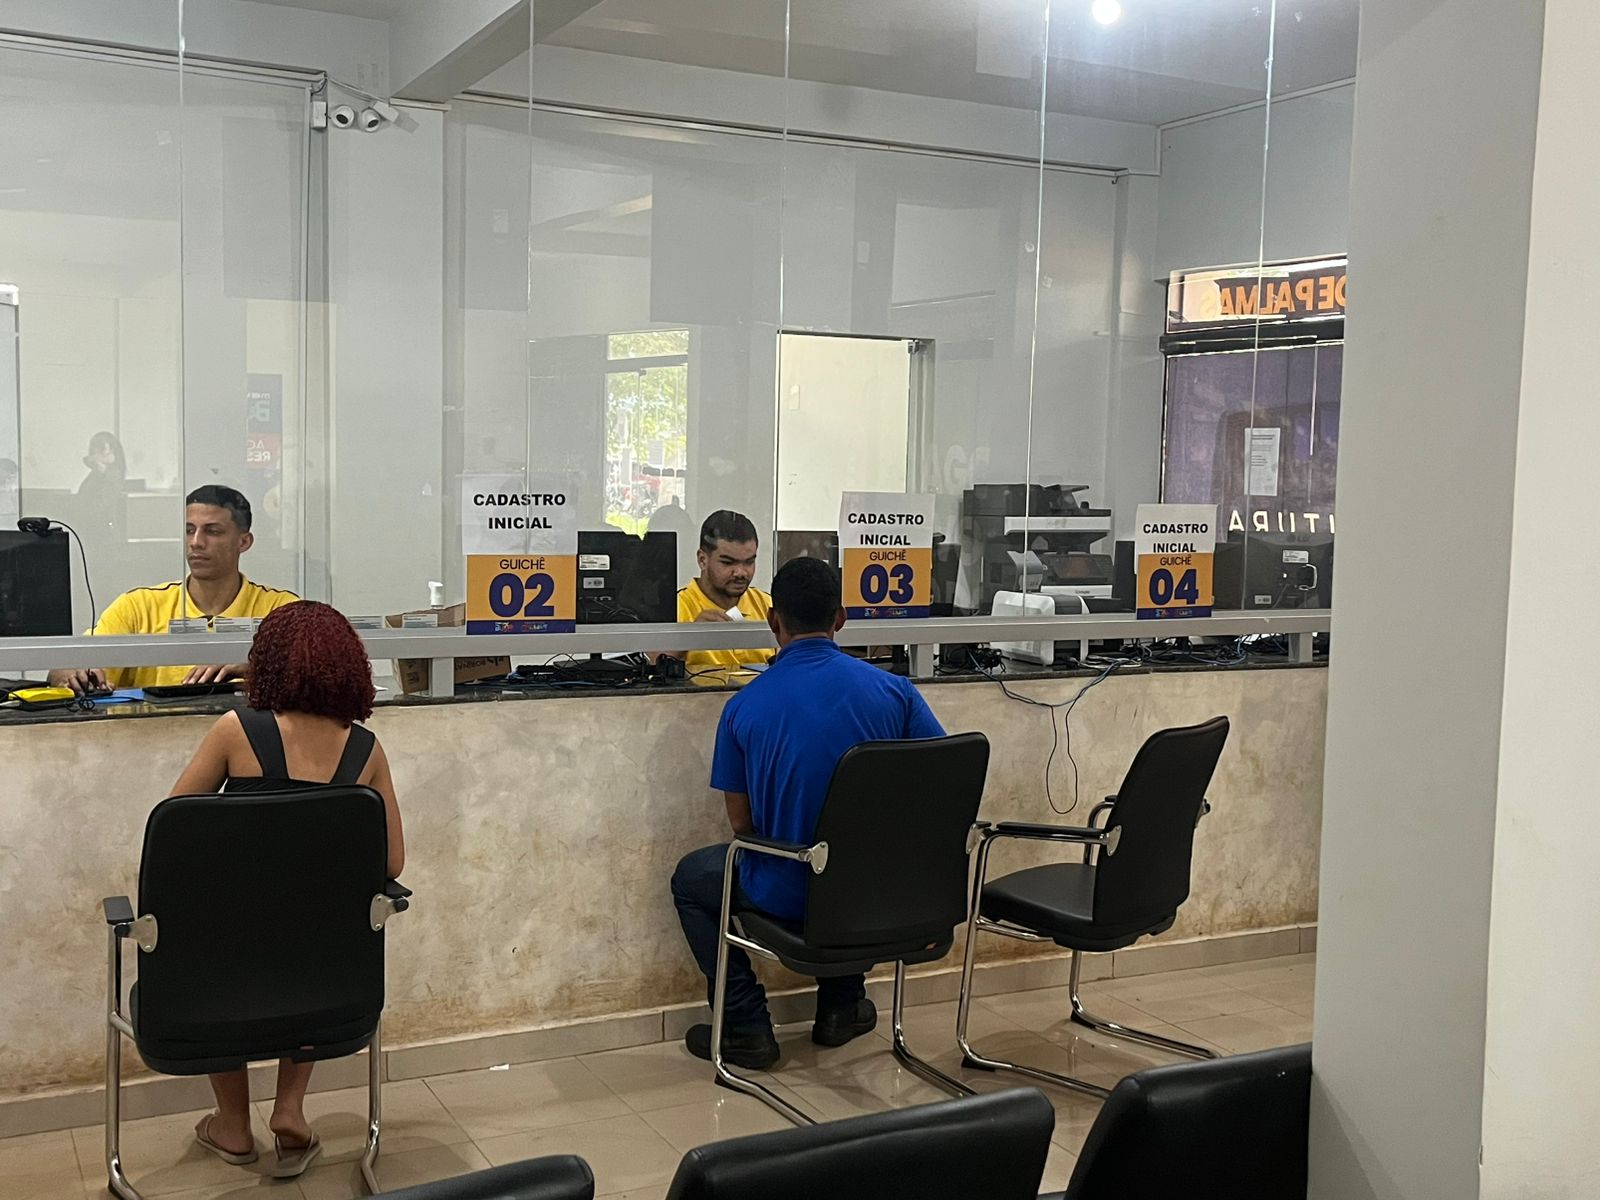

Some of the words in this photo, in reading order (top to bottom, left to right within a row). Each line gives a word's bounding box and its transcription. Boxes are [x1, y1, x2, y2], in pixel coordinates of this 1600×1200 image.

[473, 493, 566, 506] CADASTRO
[488, 517, 553, 530] INICIAL
[847, 513, 924, 525] CADASTRO
[1143, 523, 1209, 534] CADASTRO
[860, 534, 911, 546] INICIAL
[1153, 542, 1197, 553] INICIAL
[869, 549, 907, 561] GUICHÊ
[1160, 554, 1192, 566] GUICHÊ
[499, 557, 545, 570] GUICHÊ
[860, 563, 914, 605] 03
[1149, 568, 1199, 606] 04
[488, 572, 555, 618] 02
